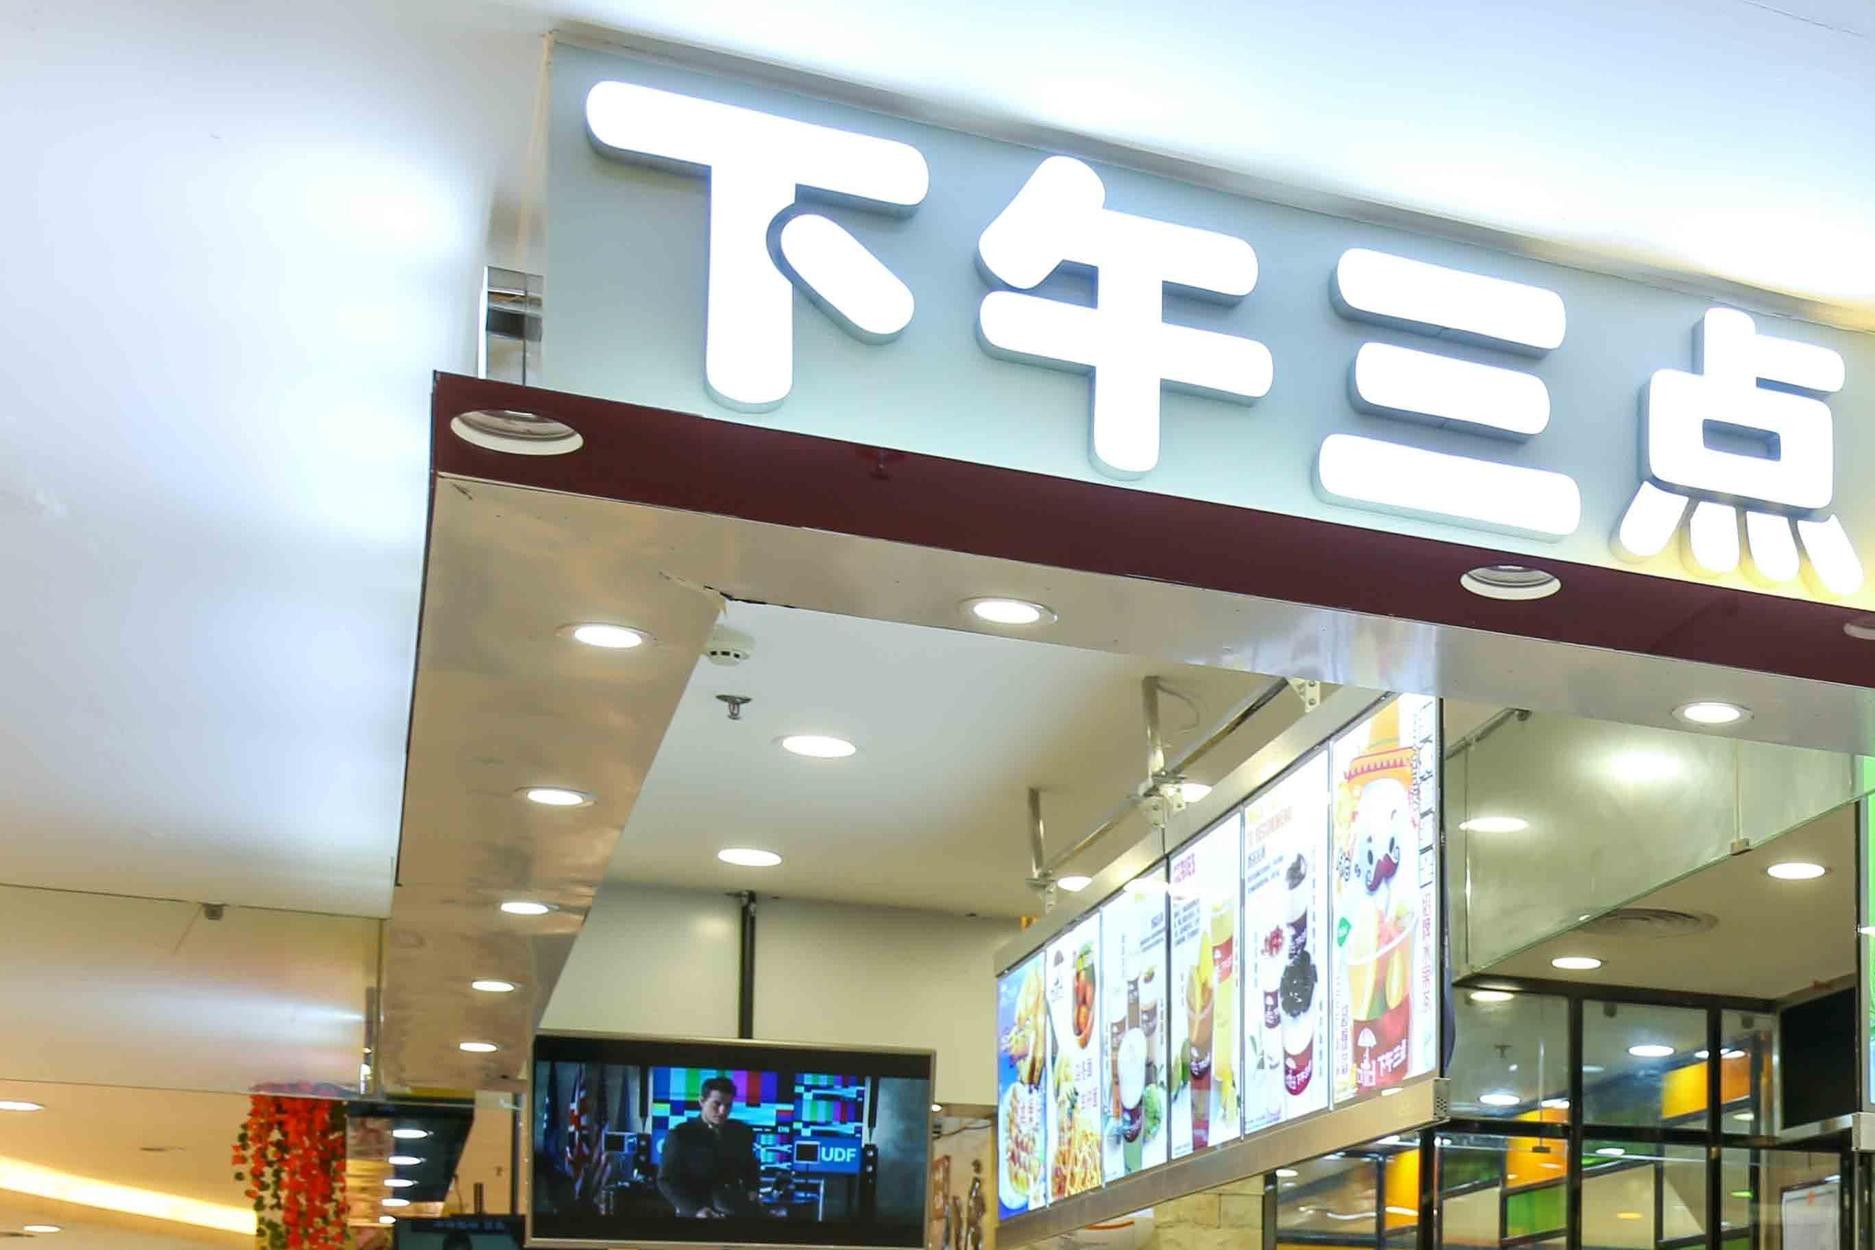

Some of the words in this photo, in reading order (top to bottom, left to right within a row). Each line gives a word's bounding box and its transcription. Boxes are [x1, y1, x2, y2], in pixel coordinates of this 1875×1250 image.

[584, 79, 1863, 596] 下午三点
[820, 1147, 857, 1163] UDF
